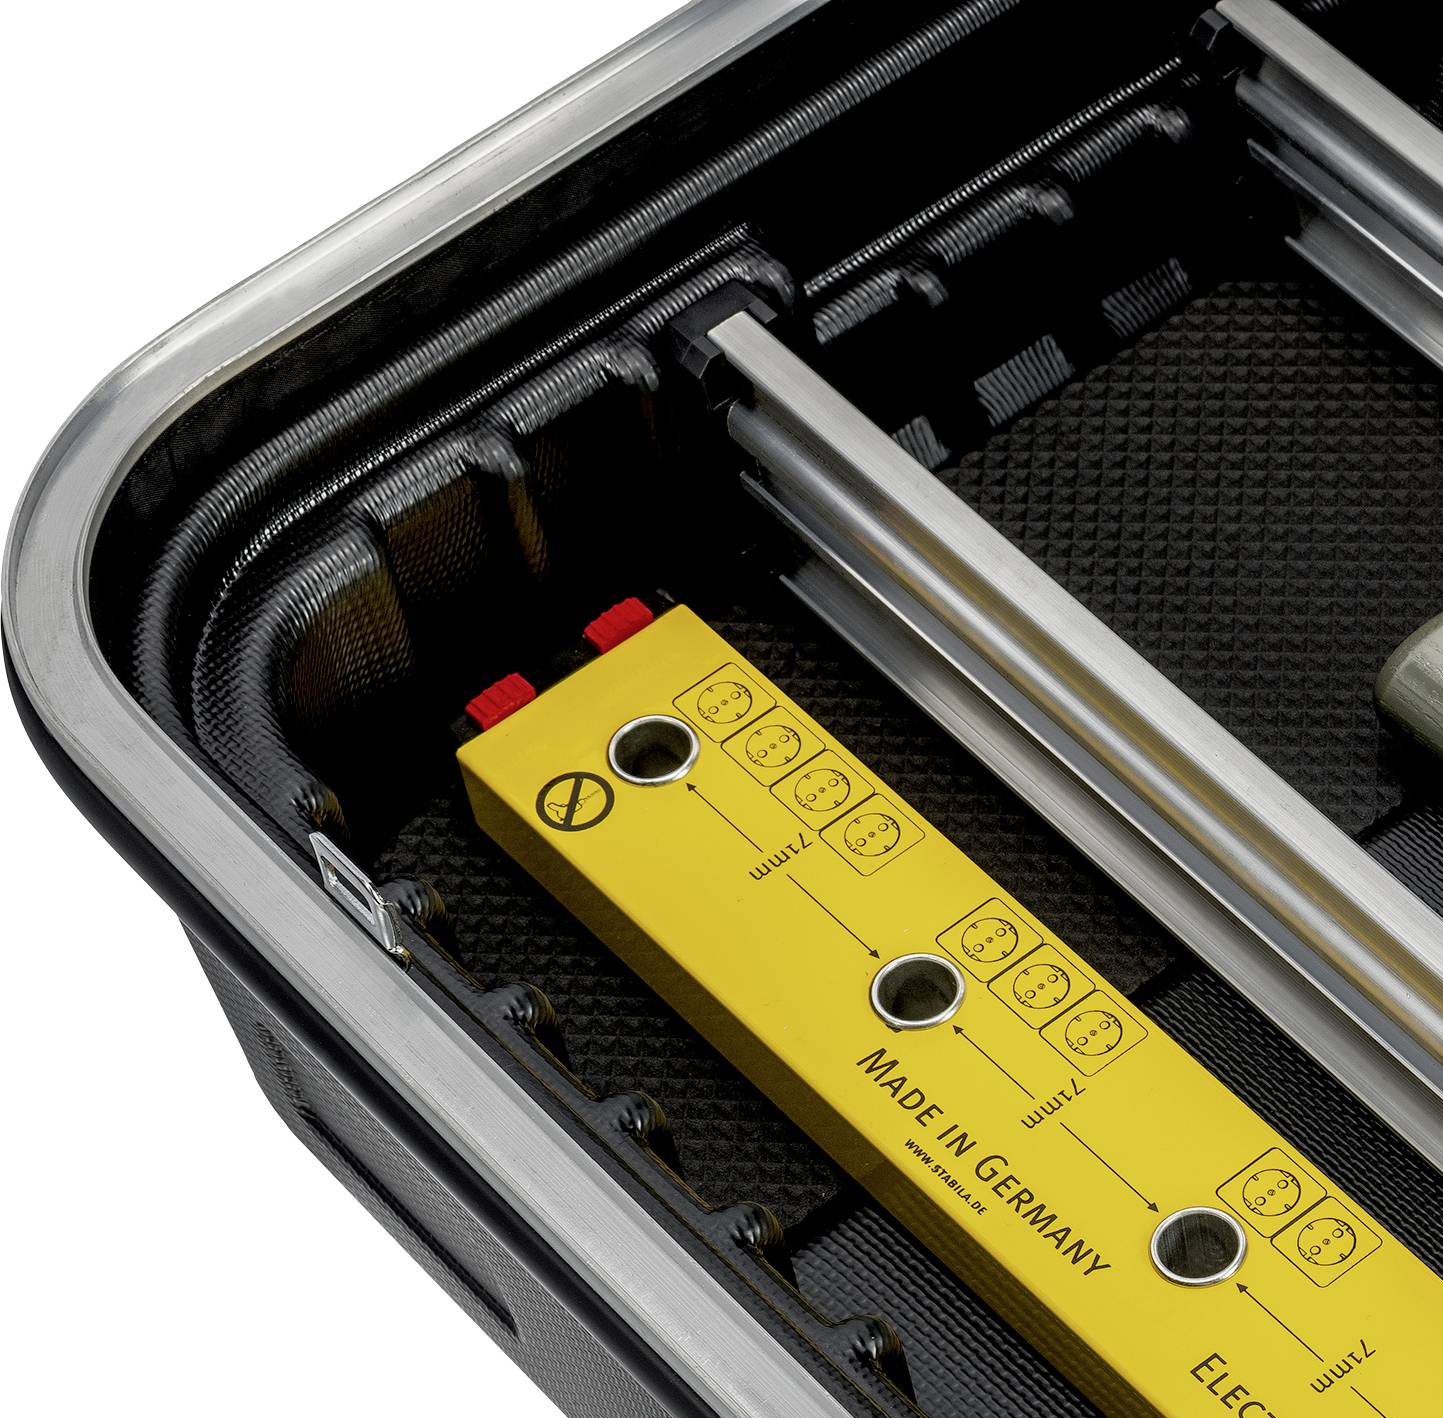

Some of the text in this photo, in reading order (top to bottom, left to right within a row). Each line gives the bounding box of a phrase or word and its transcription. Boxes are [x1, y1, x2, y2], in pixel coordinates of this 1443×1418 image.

[748, 832, 814, 881] 71mm
[1020, 1077, 1087, 1130] 71mm
[856, 1047, 1112, 1277] MADE IN GERMANY
[1309, 1338, 1377, 1394] 71mm
